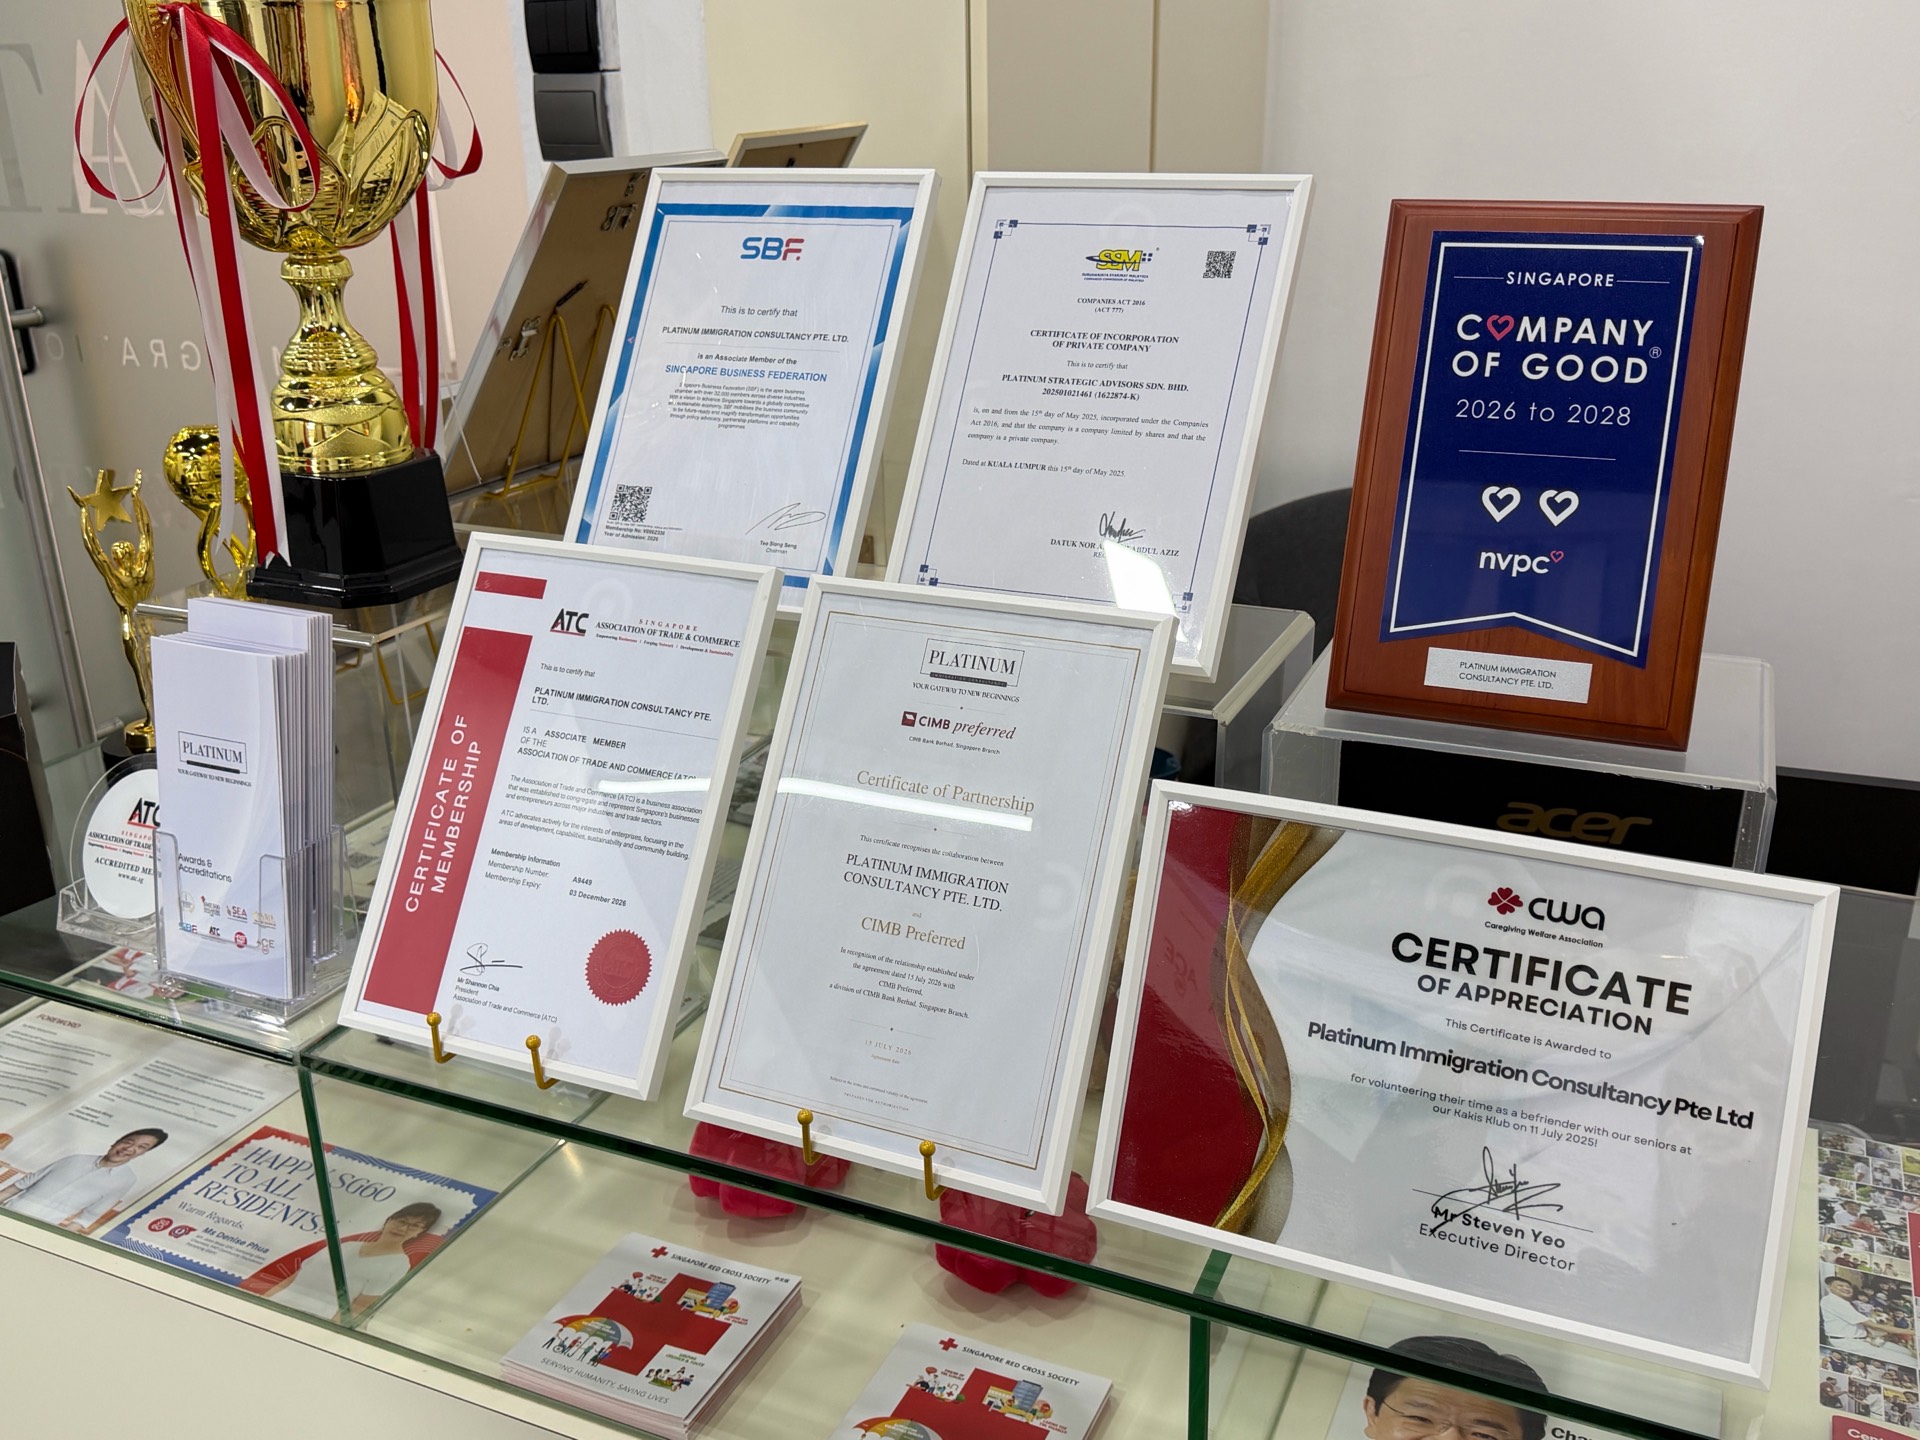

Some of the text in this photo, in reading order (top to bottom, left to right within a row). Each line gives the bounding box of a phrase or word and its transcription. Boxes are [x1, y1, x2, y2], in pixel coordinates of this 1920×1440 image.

[1507, 271, 1614, 287] SINGAPORE
[720, 305, 798, 318] This is to certify that
[661, 326, 849, 342] PLATINUM IMMIGRATION CONSULTANCY PTE. LTD.
[1030, 329, 1180, 343] CERTIFICATE OF INCORPORATION
[1051, 340, 1151, 352] OF PRIVATE COMPANY
[719, 367, 766, 378] BUSINESS
[767, 370, 828, 382] FEDERATION
[1453, 350, 1500, 378] OF
[1001, 374, 1189, 391] PLATINUM STRATEGIC ADVISORS SDN. BHD.
[1456, 400, 1631, 426] 2026 to 2028
[1480, 549, 1549, 577] nvpc
[551, 609, 589, 633] ATC
[595, 621, 741, 647] ASSOCIATION OF TRADE & COMMERCE
[638, 618, 698, 631] SINGAPORE
[928, 649, 1016, 675] PLATINUM
[1459, 661, 1557, 678] PLATINUM IMMIGRATION
[1458, 672, 1554, 689] CONSULTANCY PTE. LTD.
[531, 696, 549, 705] LTD.
[534, 686, 712, 721] PLATINUM IMMIGRATION CONSULTANCY PTE.
[544, 729, 587, 743] ASSOCIATE
[592, 736, 627, 749] MEMBER
[919, 716, 1016, 739] CIMB preferred
[183, 741, 243, 763] PLATINUM
[856, 770, 1035, 816] Certificate of Partnership
[406, 716, 468, 912] CERTIFICATE OF
[431, 742, 481, 893] MEMBERSHIP
[1496, 802, 1653, 844] acer
[87, 831, 125, 844] ASSOCIATION
[124, 838, 134, 846] OF
[94, 856, 143, 873] ACCREDITED
[178, 853, 206, 867] Awards
[179, 864, 232, 882] Accreditations
[845, 853, 1009, 894] PLATINUM IMMIGRATION
[571, 876, 593, 886] A9449
[843, 870, 1002, 912] CONSULTANCY PTE. LTD.
[568, 888, 627, 907] 03 December 2026
[1528, 898, 1605, 930] cwa
[861, 916, 966, 950] CIMB Preferred
[1484, 920, 1604, 948] Caregiving Welfare Association
[1391, 932, 1692, 1016] CERTIFICATE
[1417, 975, 1652, 1035] OF APPRECIATION
[1445, 1017, 1612, 1059] This Certificate is Awarded to
[1307, 1021, 1755, 1130] Platinum Immigration Consultancy Pte Ltd
[1350, 1072, 1367, 1084] for
[1368, 1078, 1437, 1102] volunteering
[1438, 1093, 1466, 1106] their
[1467, 1099, 1493, 1112] time
[1495, 1106, 1509, 1115] as
[1520, 1109, 1582, 1131] befriender
[1583, 1125, 1609, 1137] with
[1611, 1131, 1632, 1141] our
[1633, 1136, 1677, 1152] seniors
[1679, 1146, 1692, 1155] at
[1432, 1105, 1598, 1147] our Kakis Klub on 11 July 2025!
[222, 1163, 304, 1201] TO ALL
[331, 1172, 397, 1202] SG60
[177, 1200, 207, 1217] Warm
[201, 1226, 270, 1253] Ms Denise Phua
[1434, 1206, 1565, 1249] Mr Steven Yeo
[1420, 1223, 1574, 1271] Executive Director
[670, 1253, 772, 1284] SINGAPORE RED CROSS SOCIETY
[961, 1346, 1080, 1386] SINGAPORE RED CROSS SOCIETY
[540, 1357, 670, 1404] SERVING HUMANITY, SAVING LIVES
